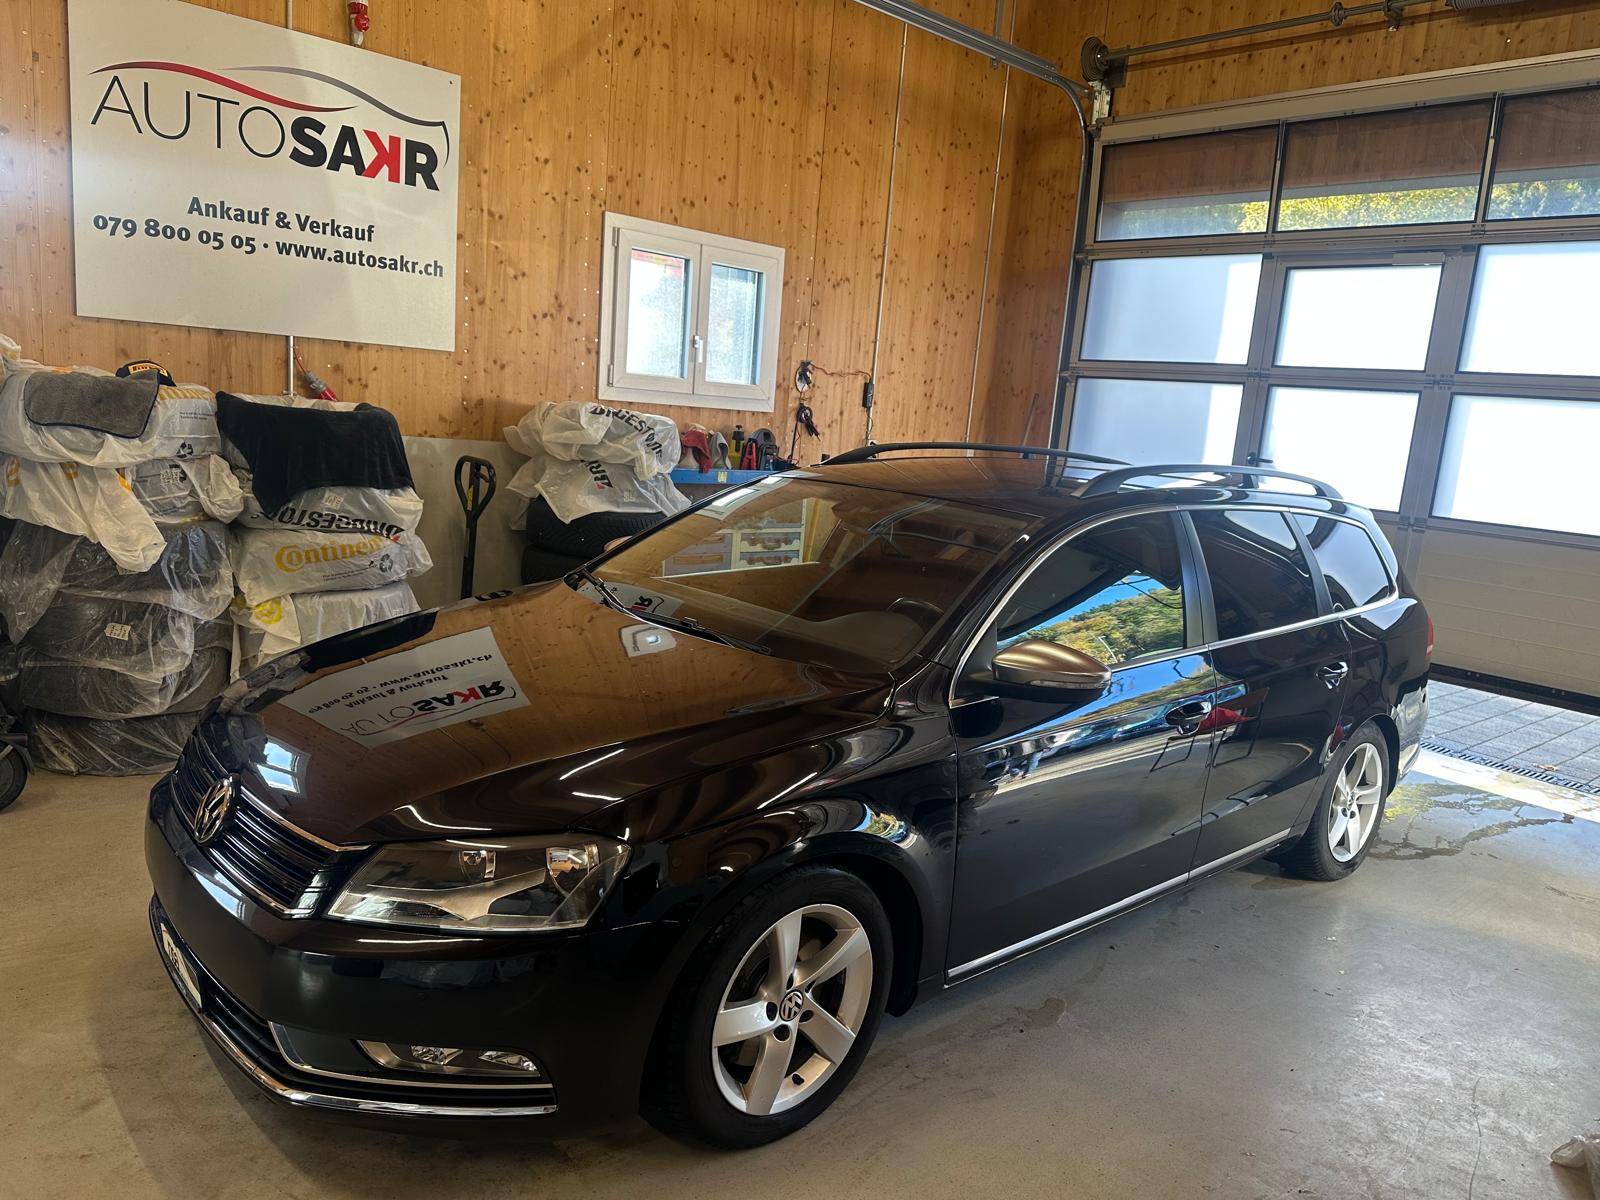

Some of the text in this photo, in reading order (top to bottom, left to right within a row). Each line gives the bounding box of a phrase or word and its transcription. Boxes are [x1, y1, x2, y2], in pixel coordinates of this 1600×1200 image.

[91, 75, 440, 191] AUTOSAKR
[93, 214, 137, 238] 079
[144, 218, 191, 241] 800
[198, 230, 224, 250] 05
[230, 235, 256, 255] 05
[275, 241, 444, 277] www.autosakr.ch
[187, 196, 375, 242] Ankauf & Verkauf
